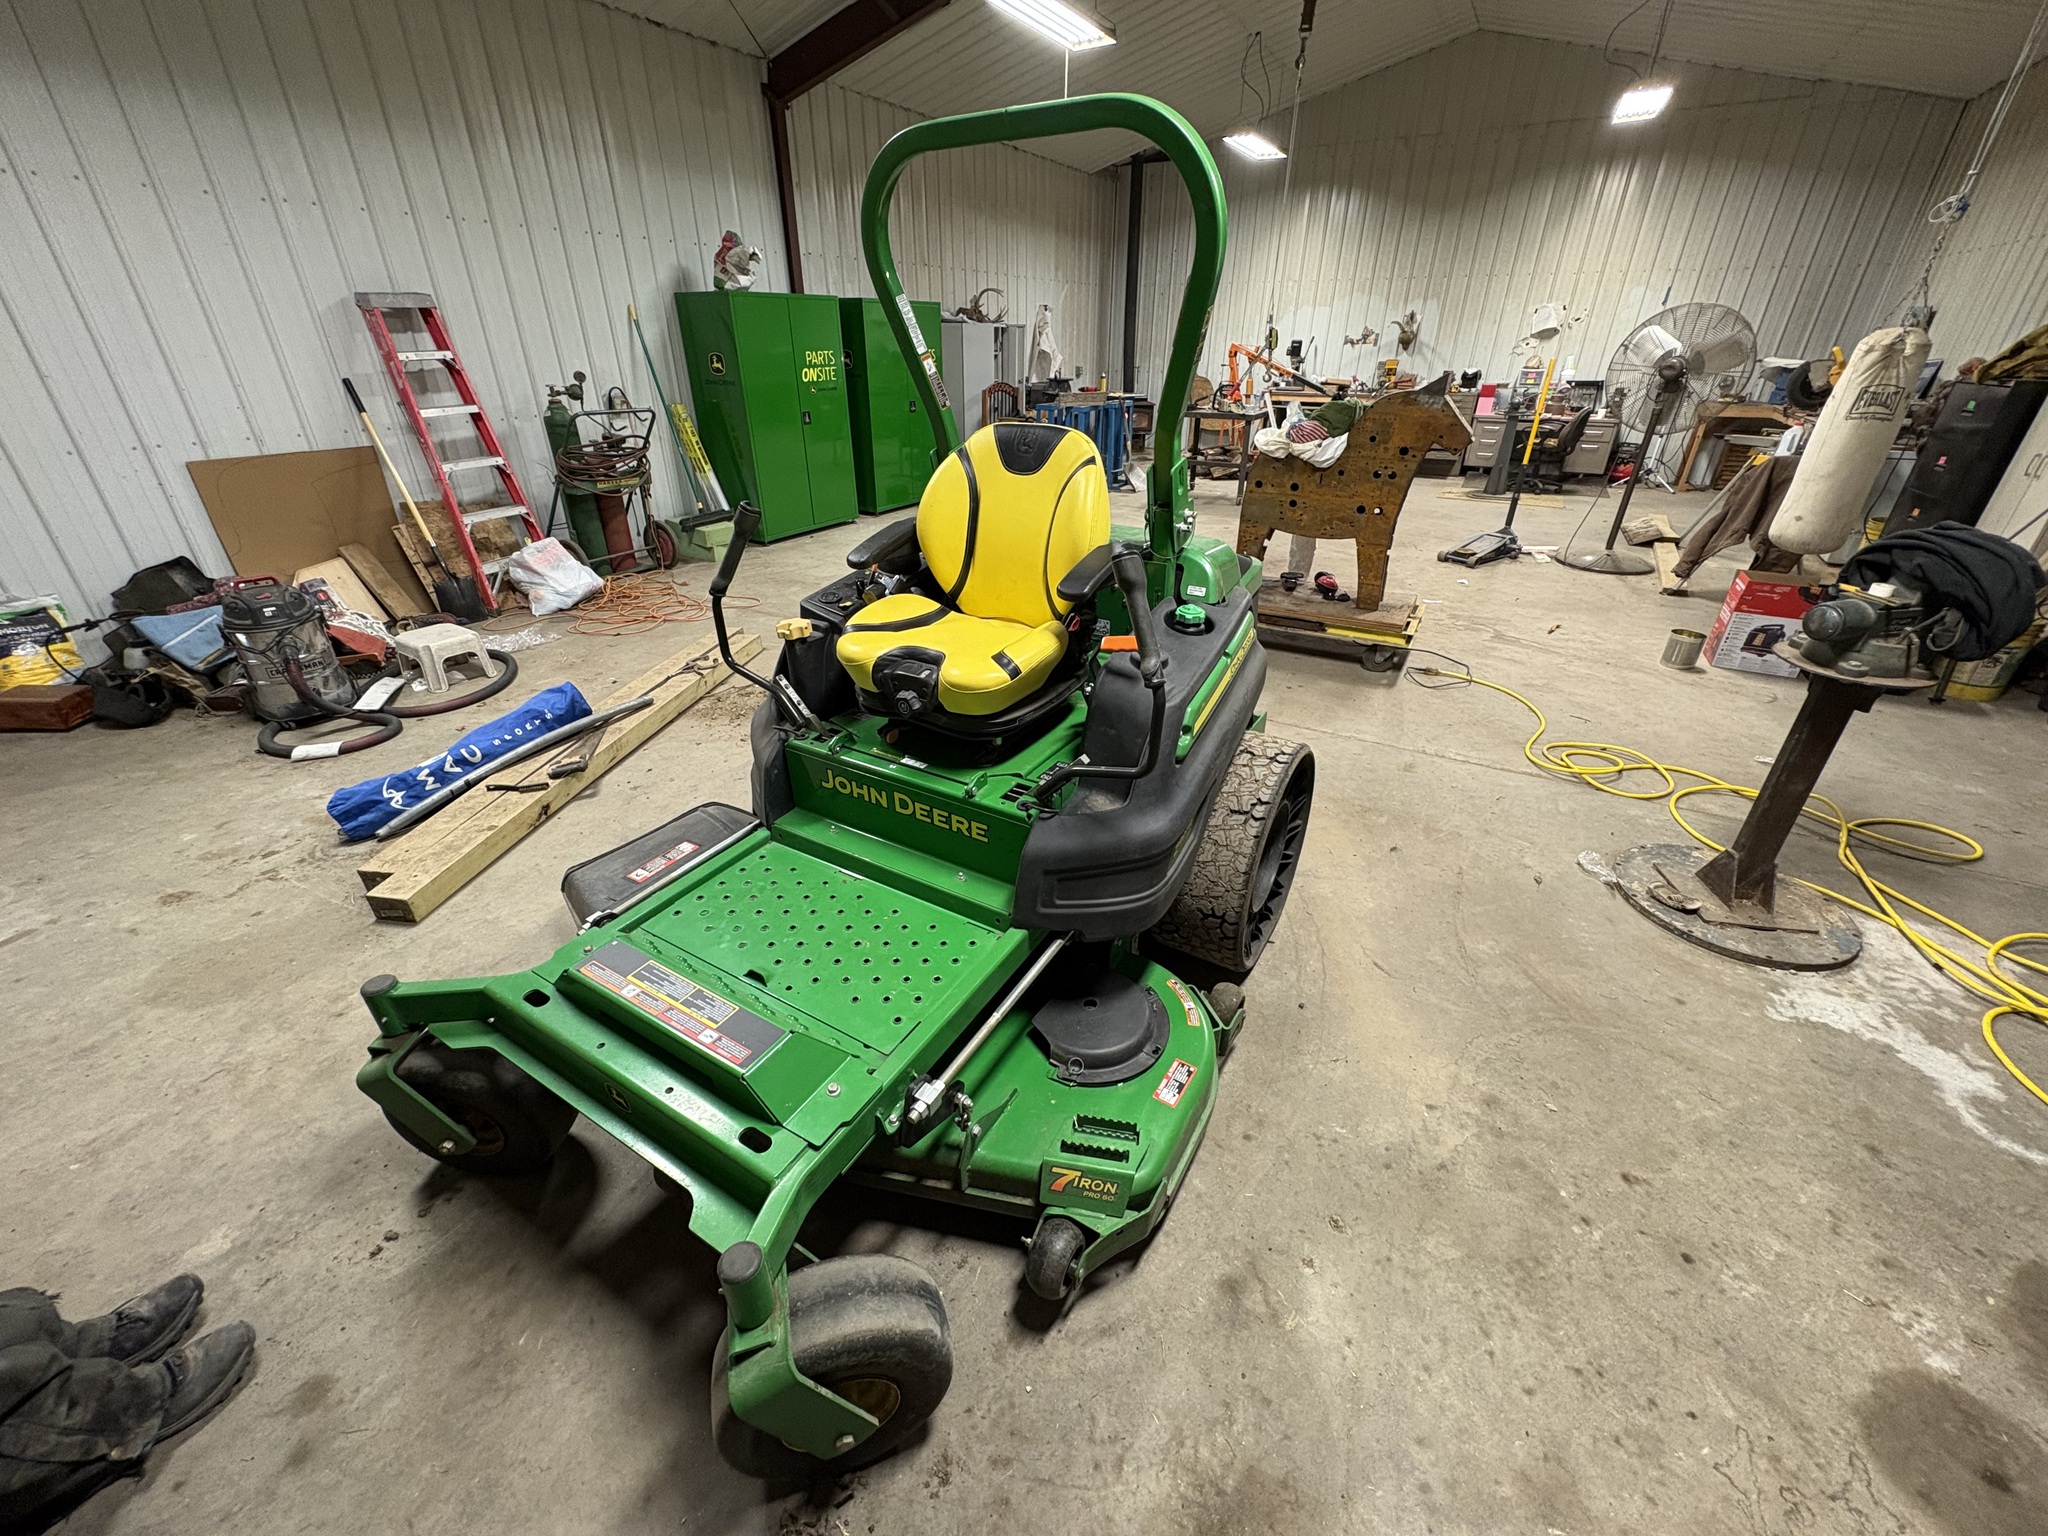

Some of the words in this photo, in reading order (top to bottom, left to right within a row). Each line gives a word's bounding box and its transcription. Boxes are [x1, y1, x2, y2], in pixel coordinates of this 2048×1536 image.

[805, 350, 836, 366] PARTS
[801, 366, 837, 383] ONSITE
[492, 710, 555, 747] SPORTS
[821, 769, 889, 809] JOHN
[893, 791, 990, 844] DEERE
[1082, 1190, 1101, 1199] PRO
[1101, 1194, 1115, 1202] 60
